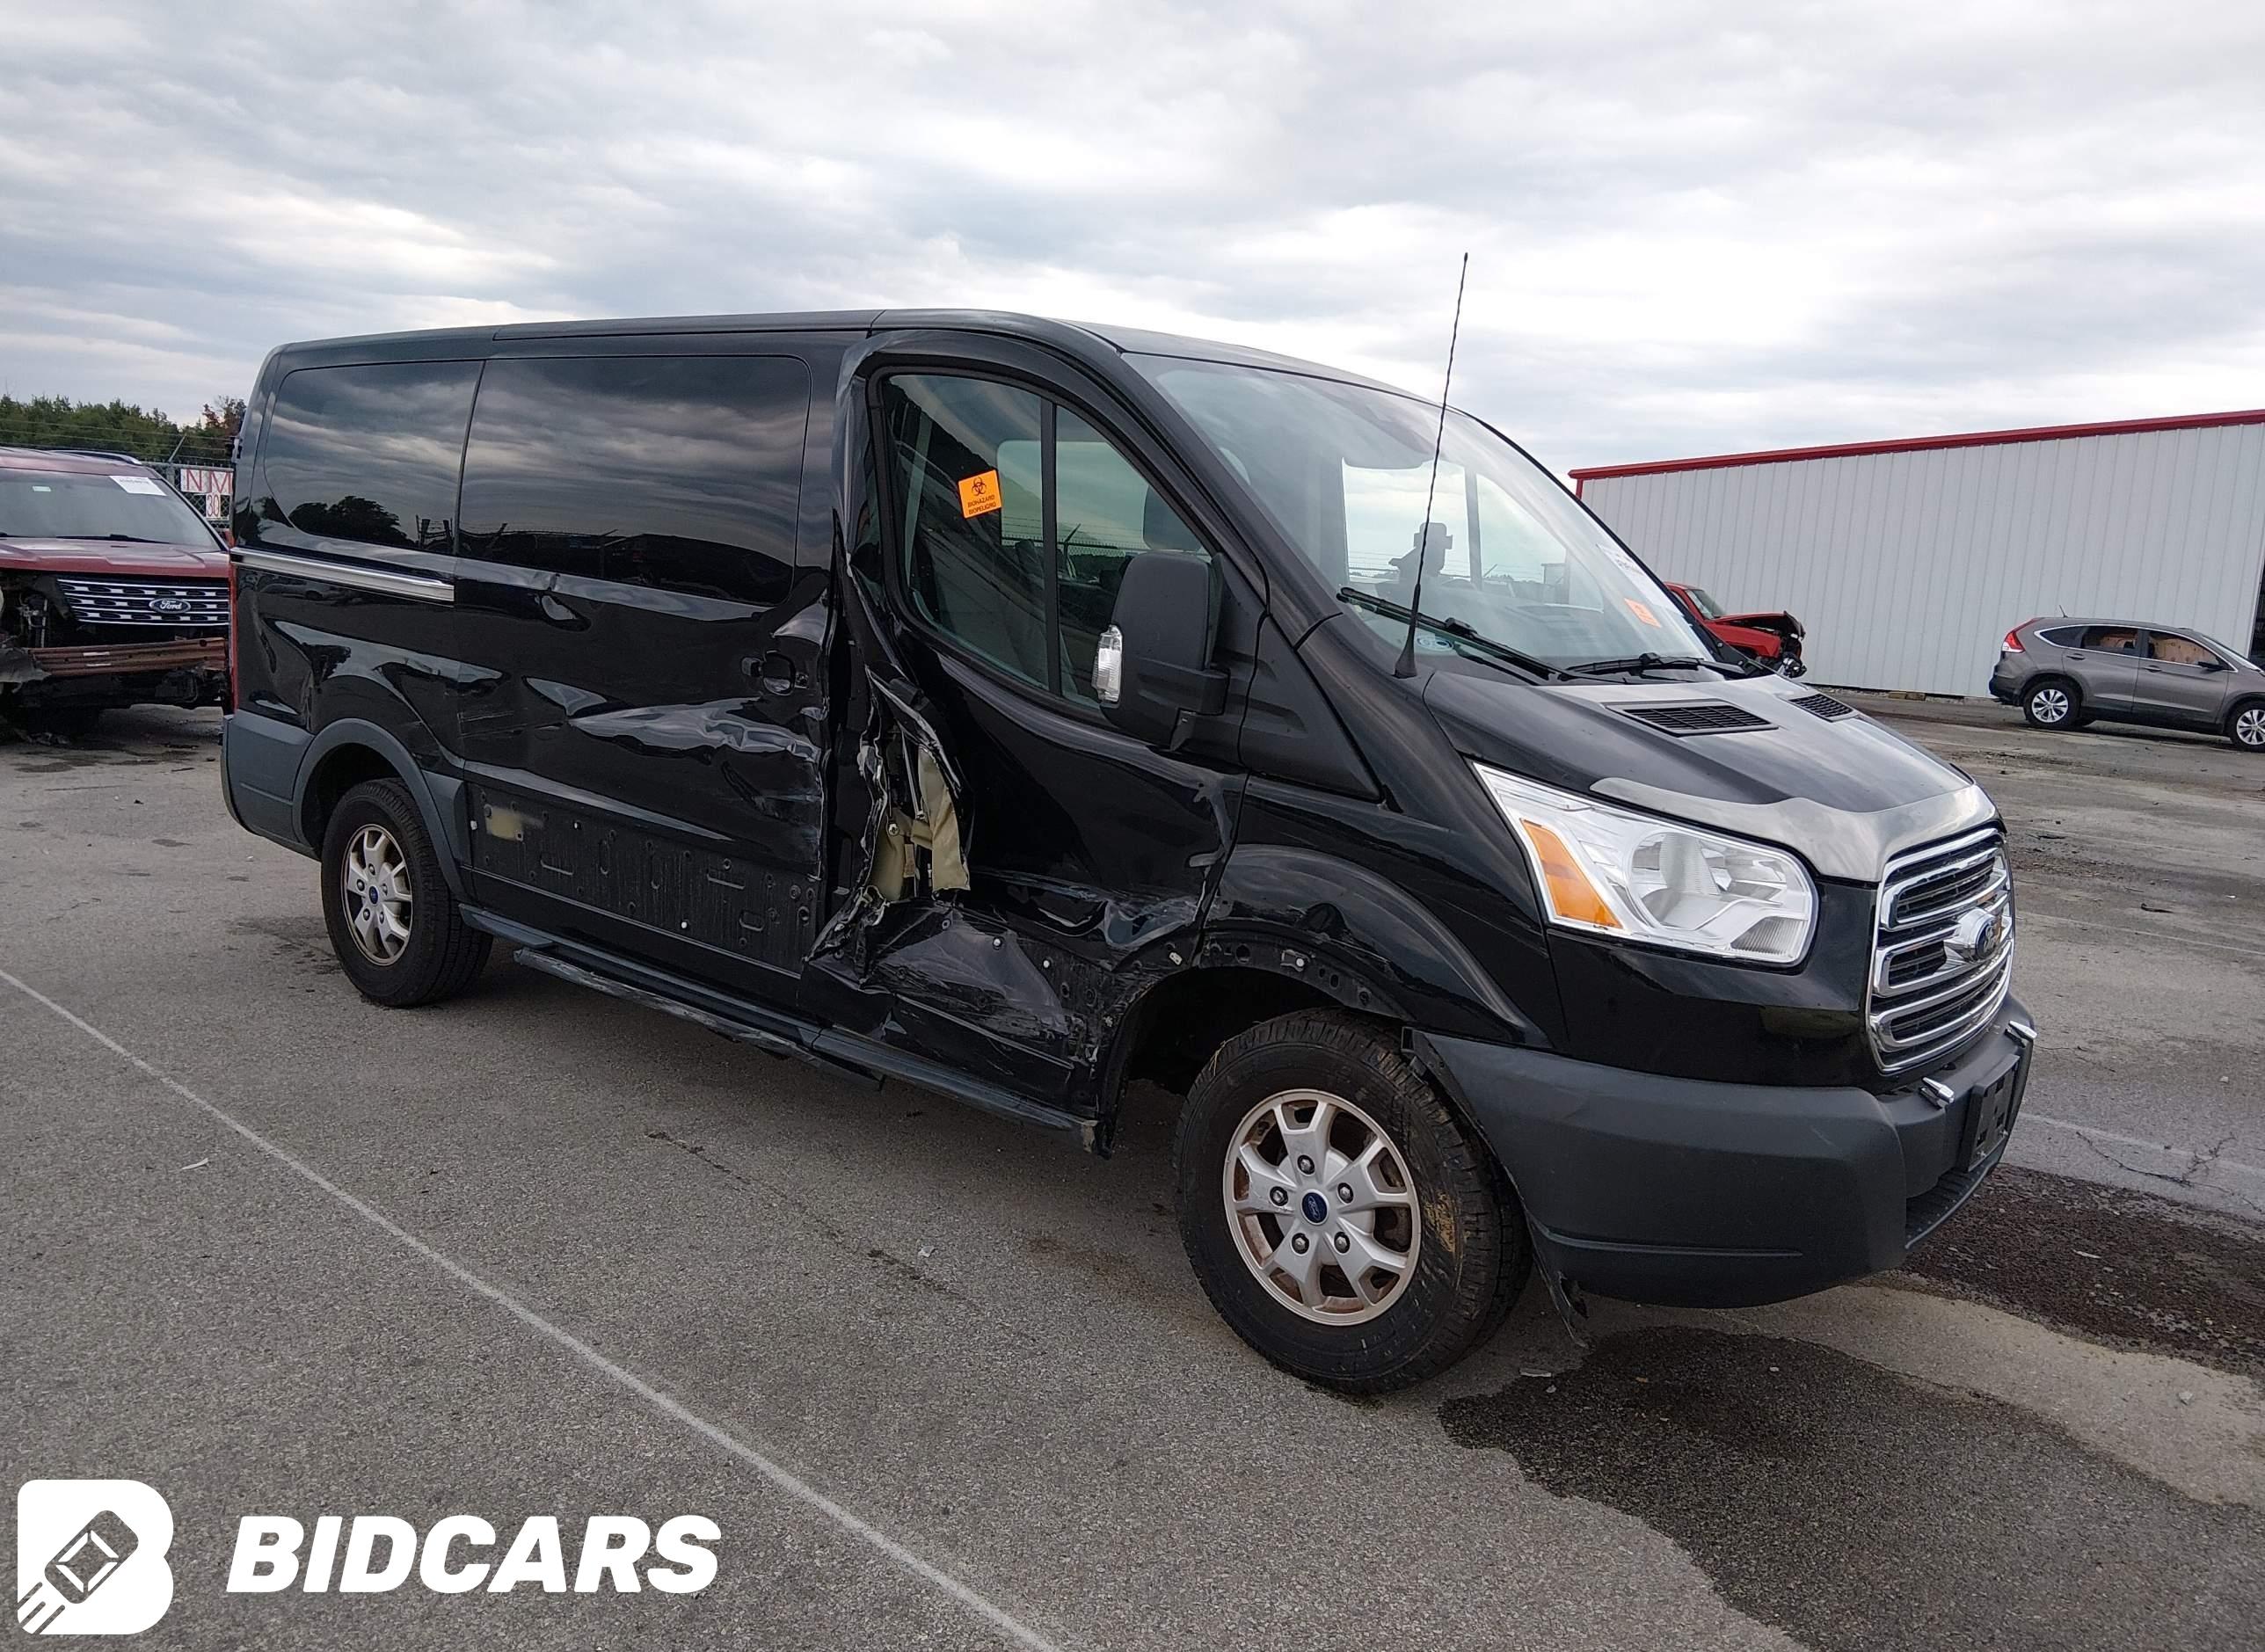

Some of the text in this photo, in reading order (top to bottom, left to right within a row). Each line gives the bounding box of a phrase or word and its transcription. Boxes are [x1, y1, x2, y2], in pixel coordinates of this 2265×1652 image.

[207, 494, 220, 517] 30
[967, 494, 995, 508] BIOHAZARD
[160, 600, 183, 609] Ford
